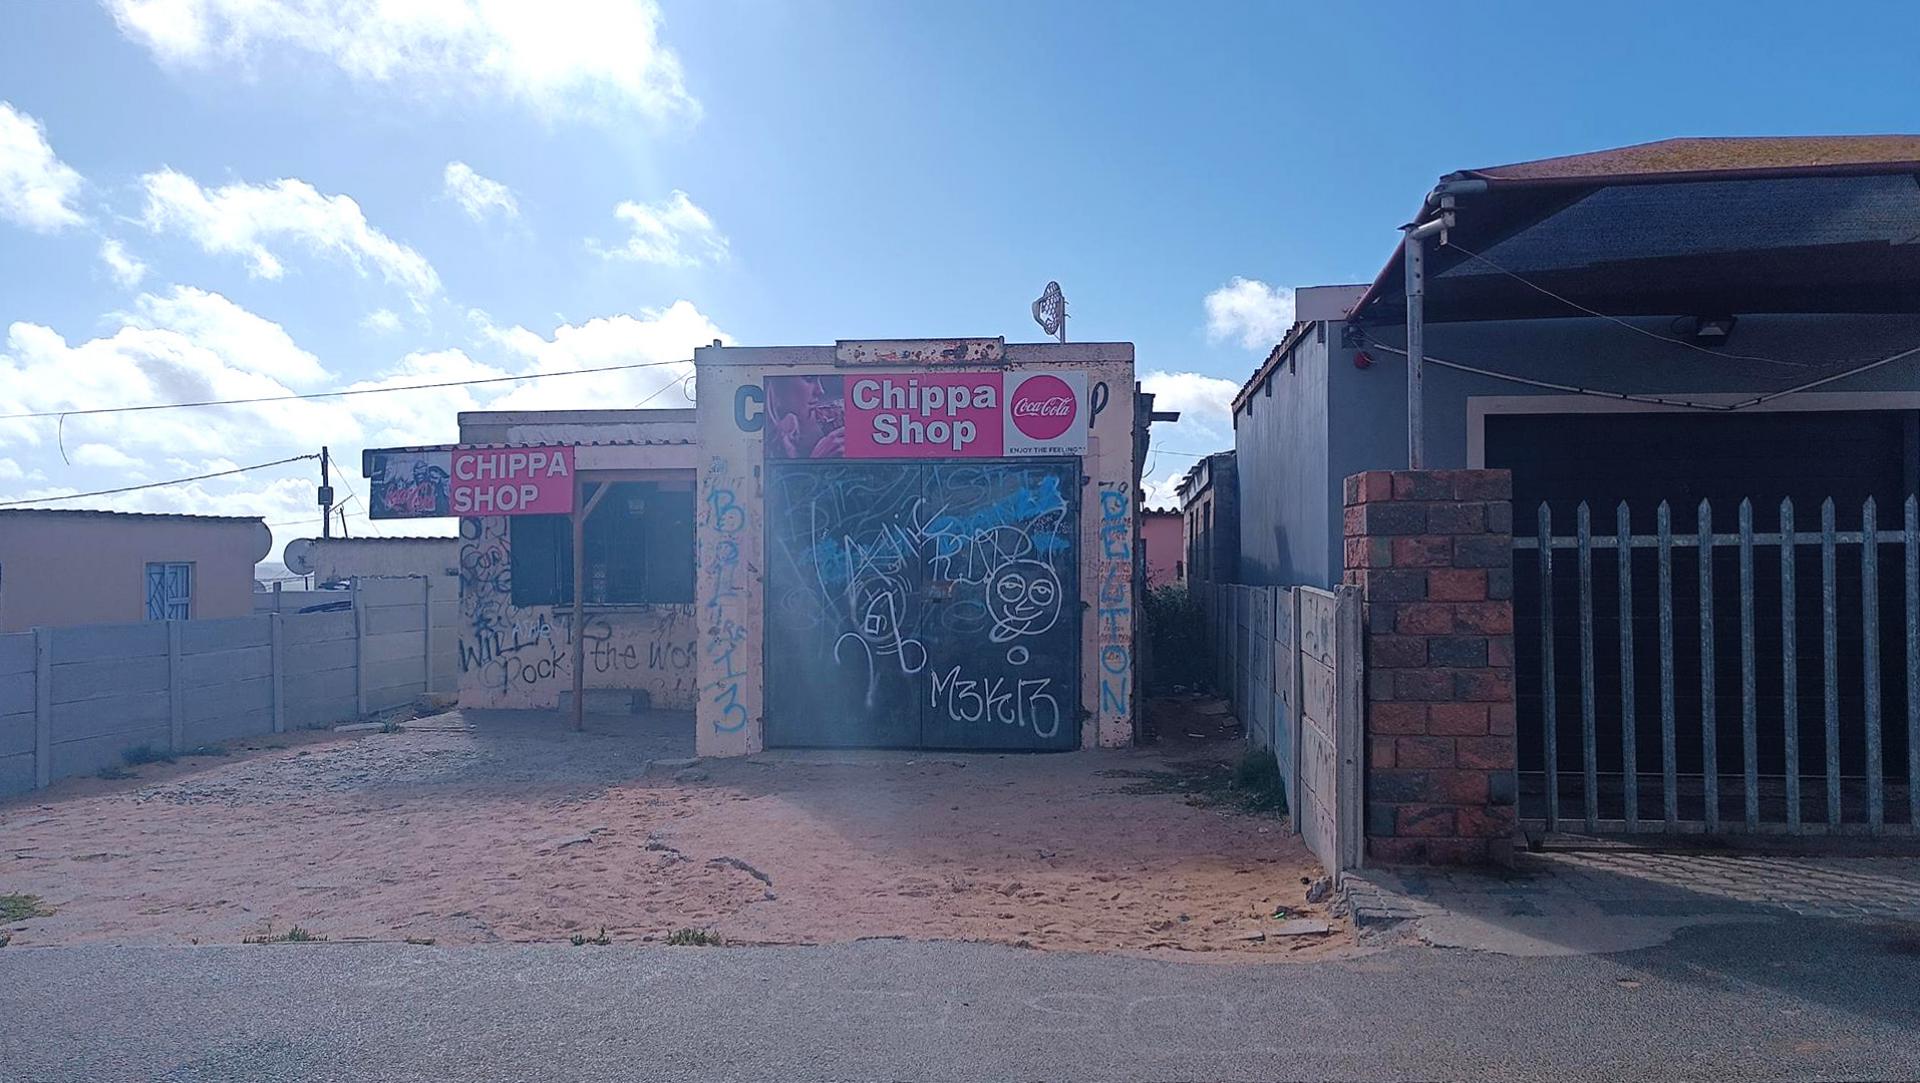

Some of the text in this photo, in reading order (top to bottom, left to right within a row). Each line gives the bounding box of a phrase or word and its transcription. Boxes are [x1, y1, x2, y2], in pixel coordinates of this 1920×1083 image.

[852, 379, 997, 417] Chippa
[1014, 396, 1073, 417] Coca-Cola
[872, 413, 977, 451] Shop
[1033, 446, 1047, 454] THE
[455, 451, 569, 480] CHIPPA
[454, 484, 538, 512] SHOP
[590, 640, 640, 672] the
